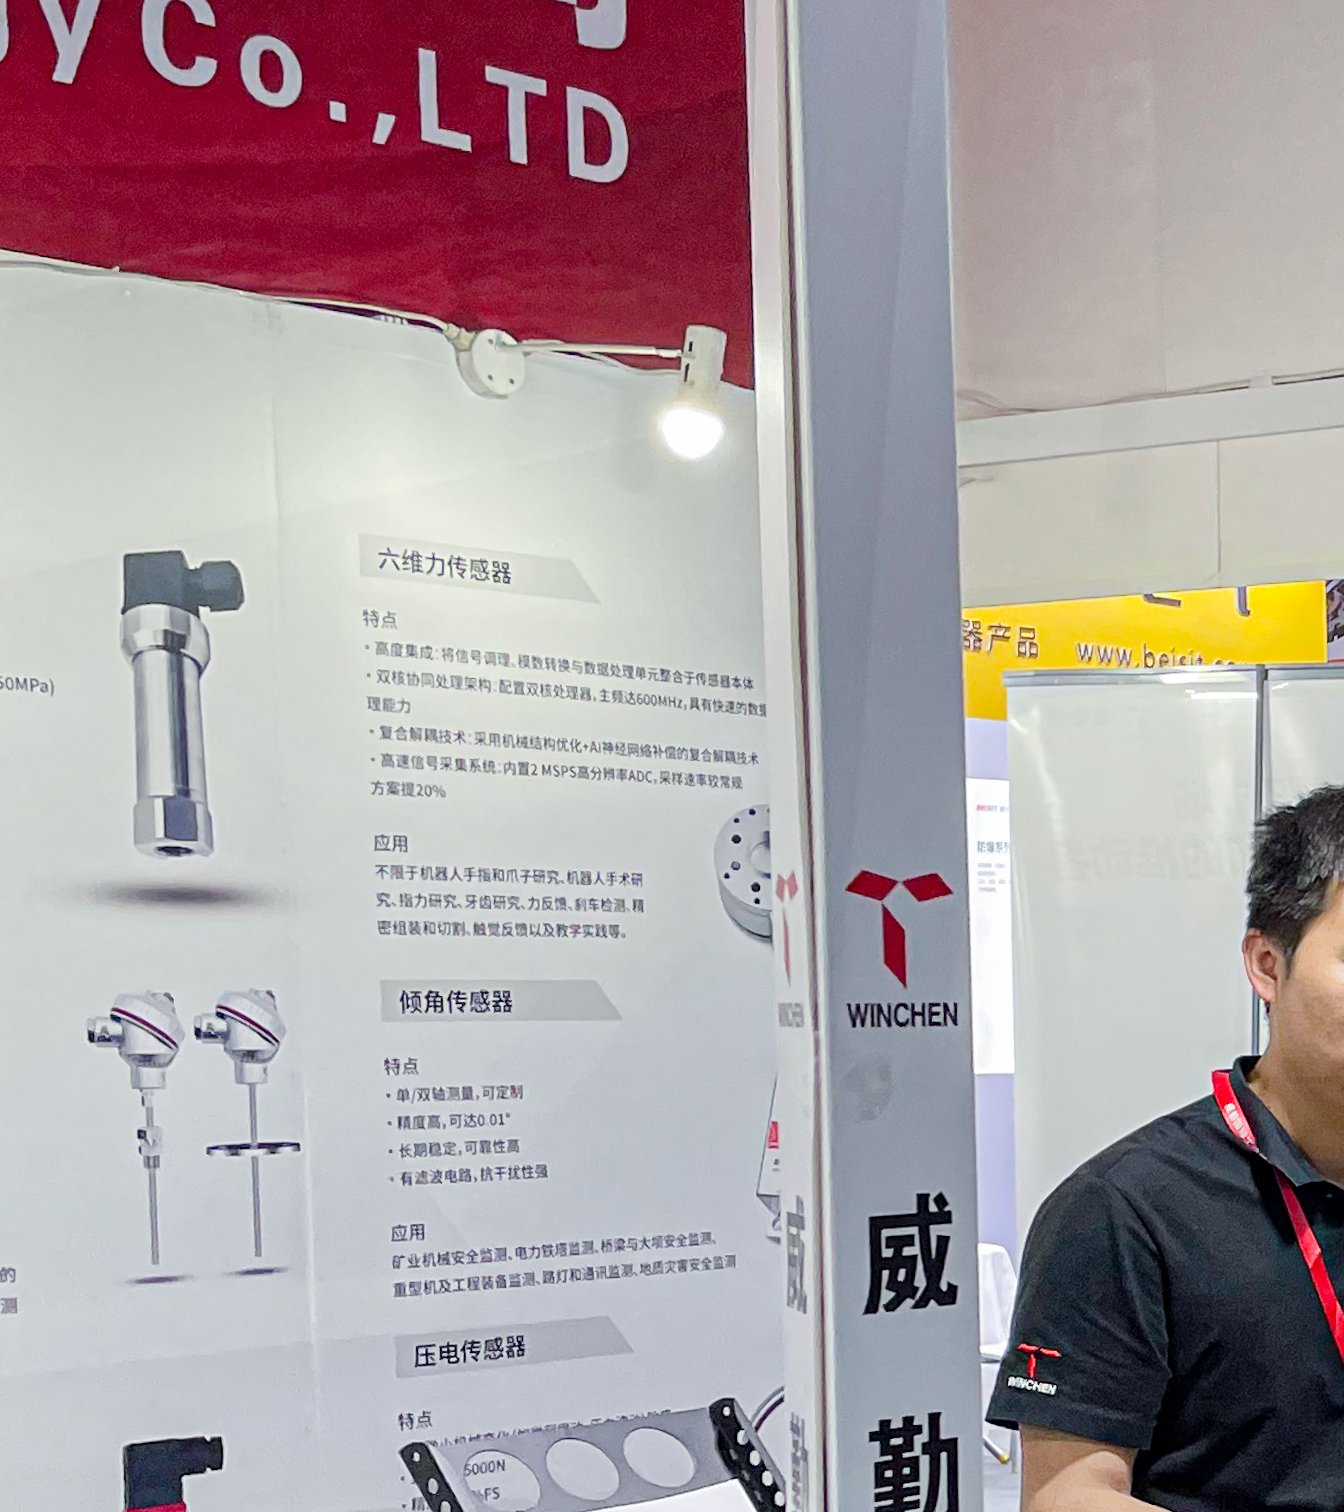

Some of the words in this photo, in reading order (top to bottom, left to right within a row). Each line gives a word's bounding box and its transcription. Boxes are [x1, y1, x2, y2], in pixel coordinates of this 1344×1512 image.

[377, 547, 512, 586] 六维力传感器
[362, 608, 399, 629] 特点
[962, 618, 1040, 660] 器产品
[374, 834, 409, 853] 应用
[400, 988, 514, 1014] 倾角传感器
[847, 1001, 959, 1029] WINCHEN
[383, 1056, 420, 1076] 特点
[391, 1222, 426, 1242] 应用
[414, 1335, 526, 1369] 压电传感器
[398, 1411, 433, 1432] 特点
